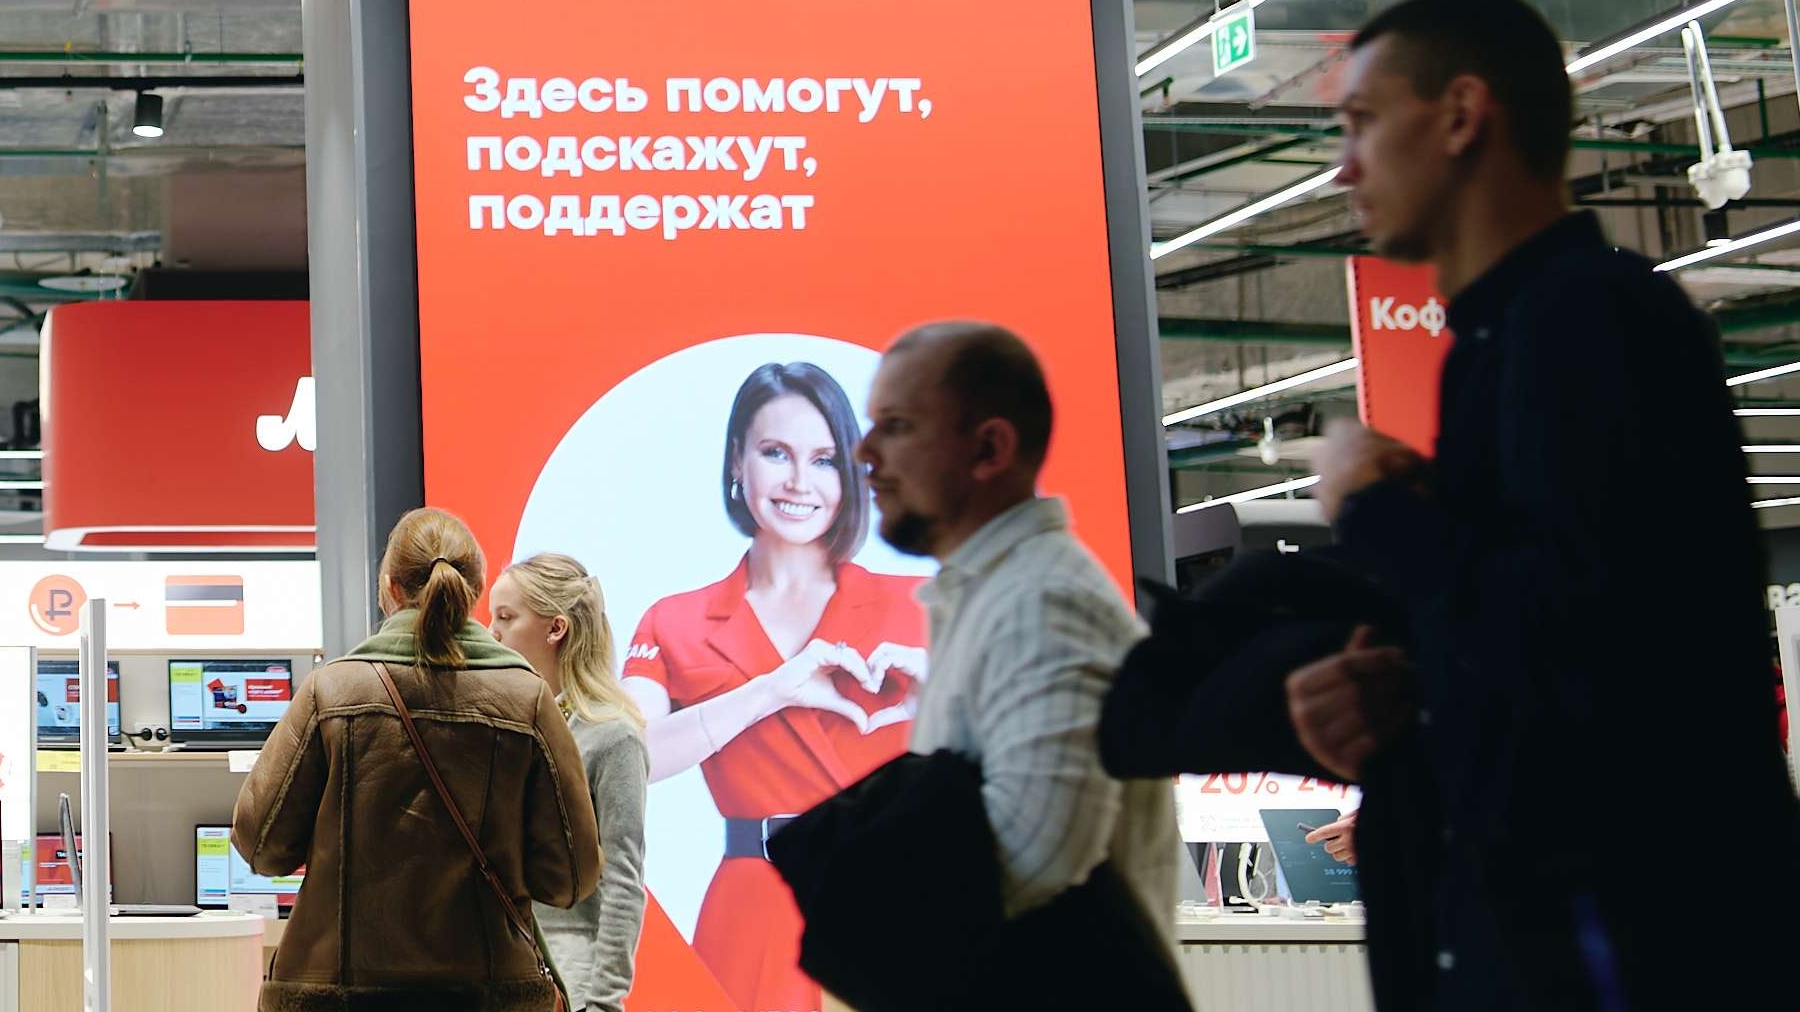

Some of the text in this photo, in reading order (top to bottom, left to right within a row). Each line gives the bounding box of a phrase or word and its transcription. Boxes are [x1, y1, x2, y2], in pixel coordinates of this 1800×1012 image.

[462, 65, 934, 123] Здесь помогут,
[466, 132, 818, 182] подскажут,
[468, 190, 815, 241] поддержат
